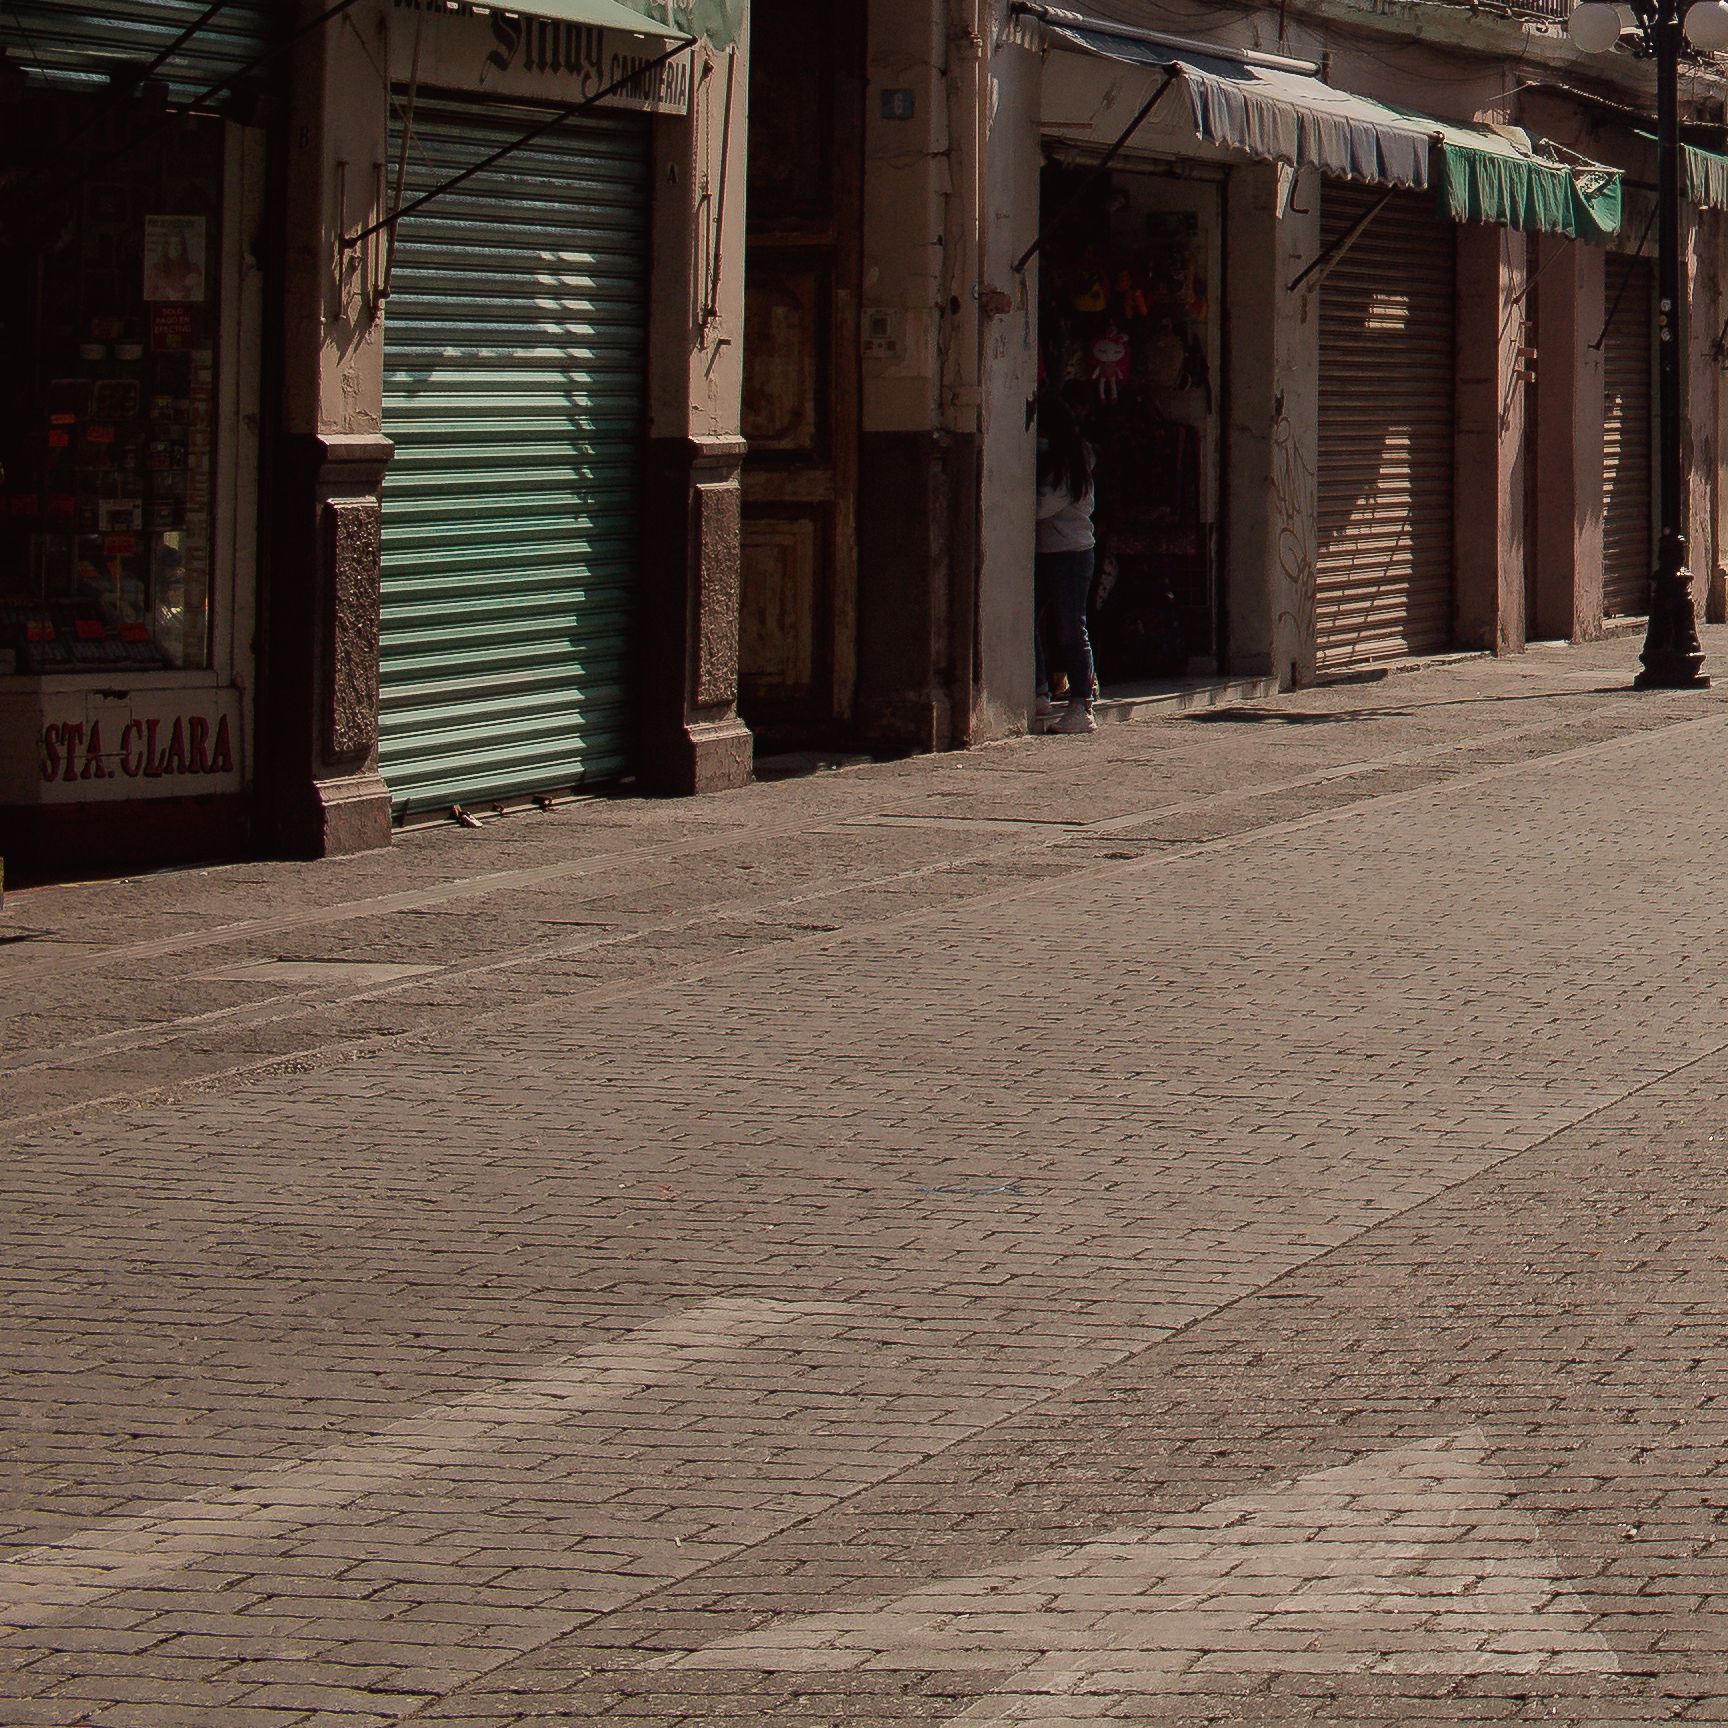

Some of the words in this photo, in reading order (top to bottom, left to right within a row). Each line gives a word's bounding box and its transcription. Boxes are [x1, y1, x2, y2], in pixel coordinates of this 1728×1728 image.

[891, 93, 904, 116] 6
[666, 164, 679, 185] A
[41, 719, 115, 783] STA.
[120, 713, 234, 779] CLARA
